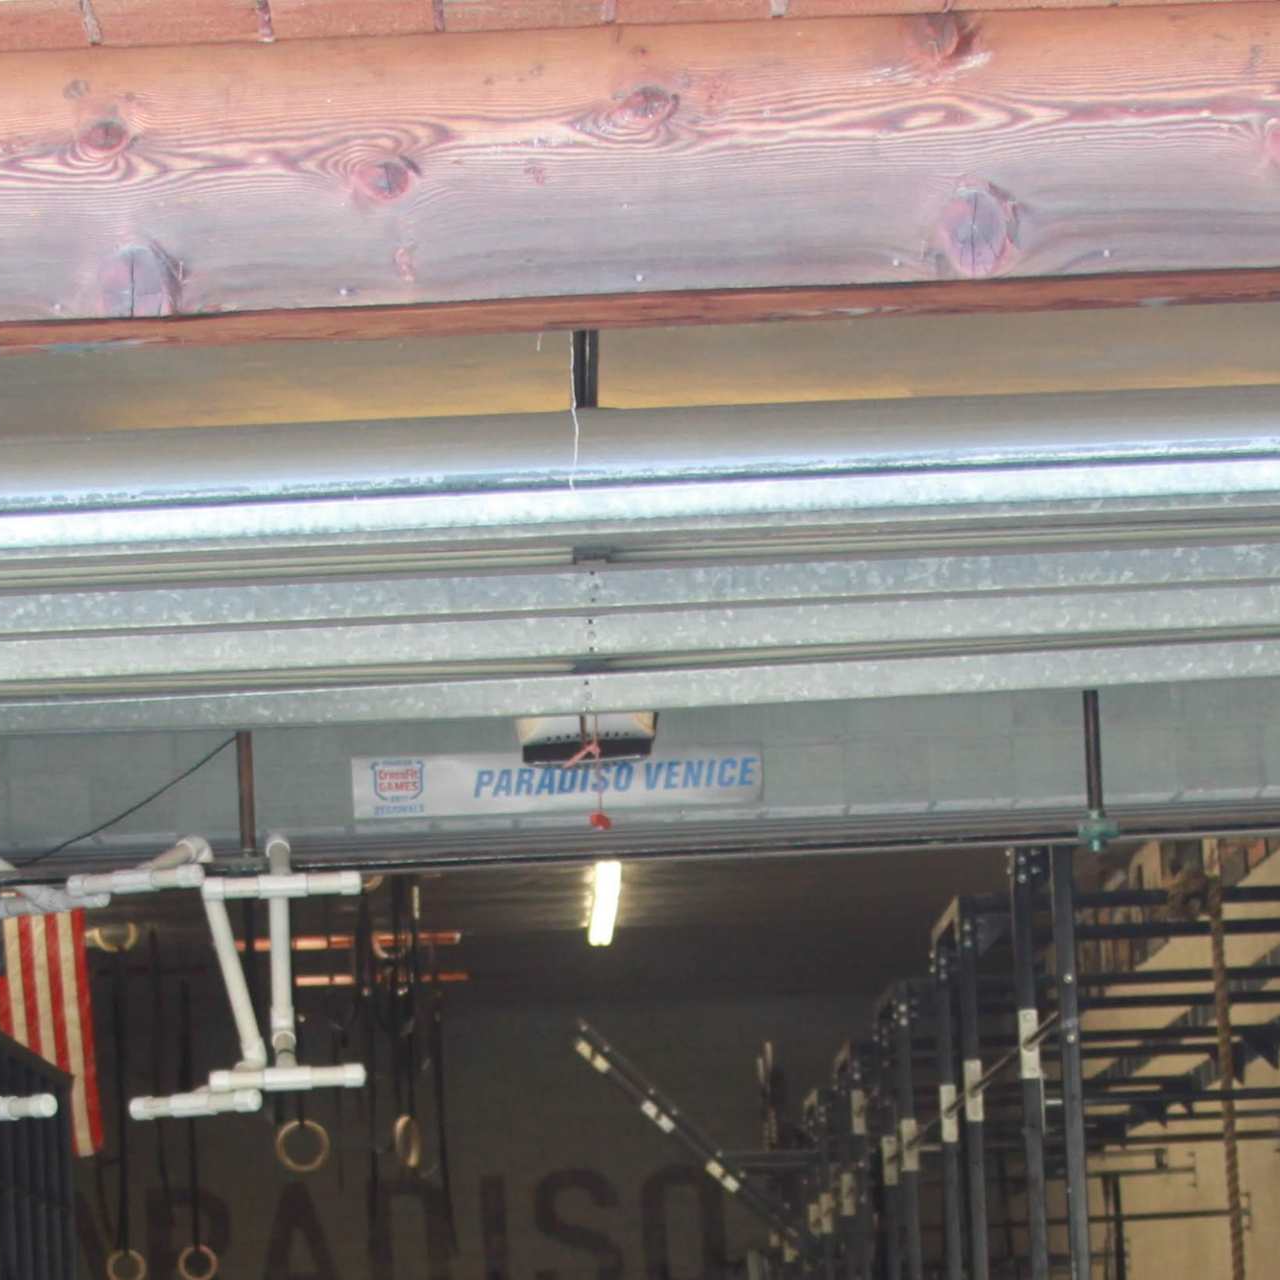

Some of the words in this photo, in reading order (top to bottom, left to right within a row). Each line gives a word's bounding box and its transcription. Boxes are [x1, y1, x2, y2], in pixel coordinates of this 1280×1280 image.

[379, 781, 418, 793] GAMES
[474, 761, 634, 799] PARADISO
[643, 755, 759, 791] VENICE
